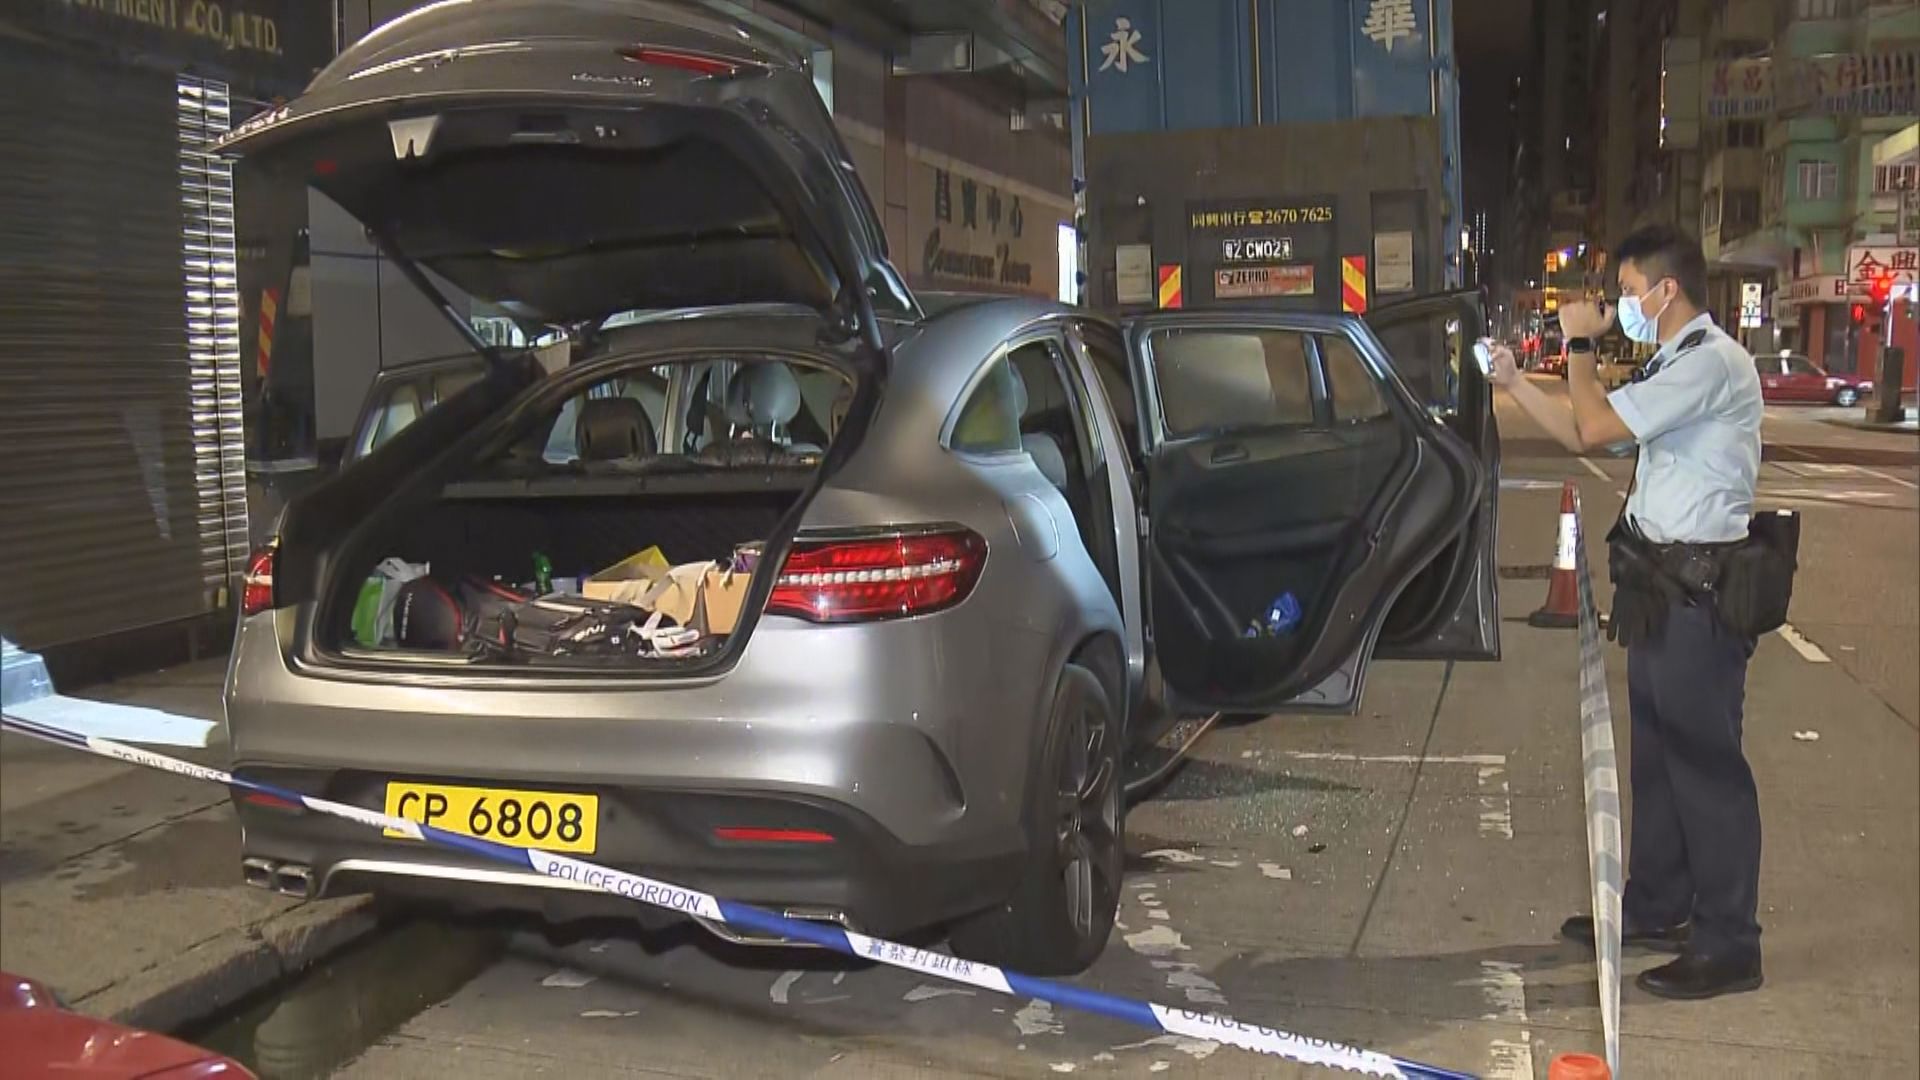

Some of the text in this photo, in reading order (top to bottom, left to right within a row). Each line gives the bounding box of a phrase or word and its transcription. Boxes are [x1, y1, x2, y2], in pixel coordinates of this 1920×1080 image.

[1098, 0, 1417, 73] 永 華
[1264, 207, 1299, 225] 2670
[1300, 206, 1333, 223] 7625
[398, 791, 449, 827] CP
[468, 796, 584, 843] 6808
[548, 861, 702, 912] POLICE CORDON
